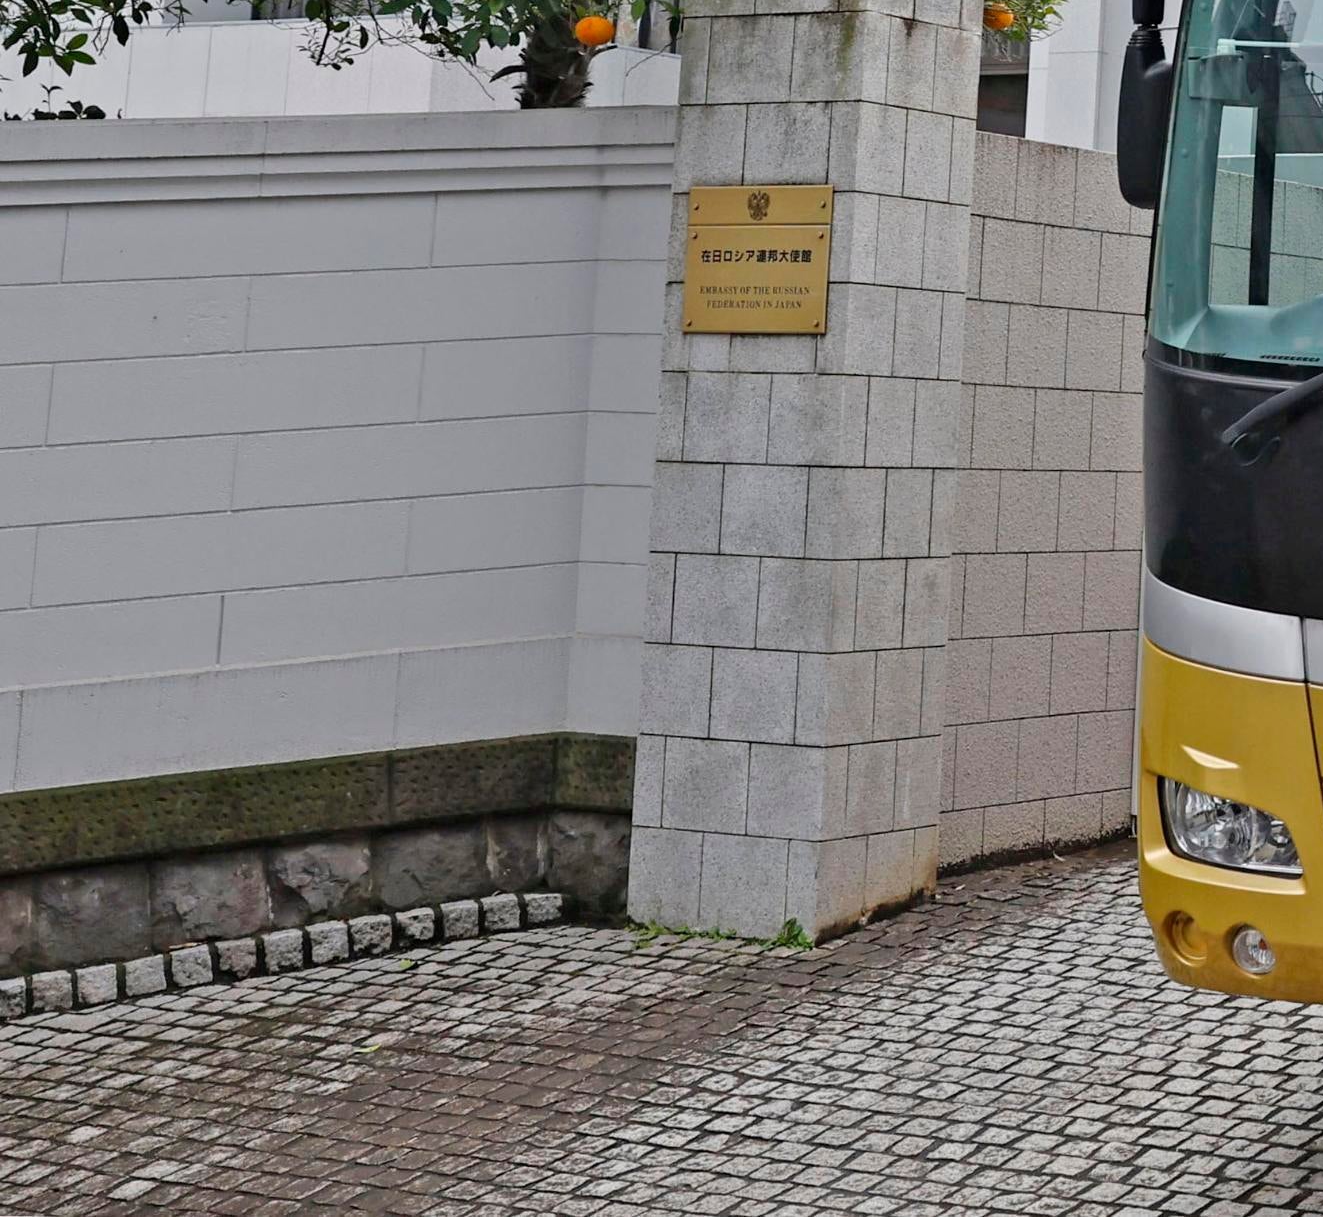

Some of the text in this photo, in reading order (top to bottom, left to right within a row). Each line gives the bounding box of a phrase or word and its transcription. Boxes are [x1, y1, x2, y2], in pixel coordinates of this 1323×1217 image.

[701, 249, 812, 263] 在日ロシア連邦大使館
[700, 286, 809, 295] EMBASSY OF THE RUSSIAN
[706, 300, 802, 309] FEDERATION IN JAPAN
